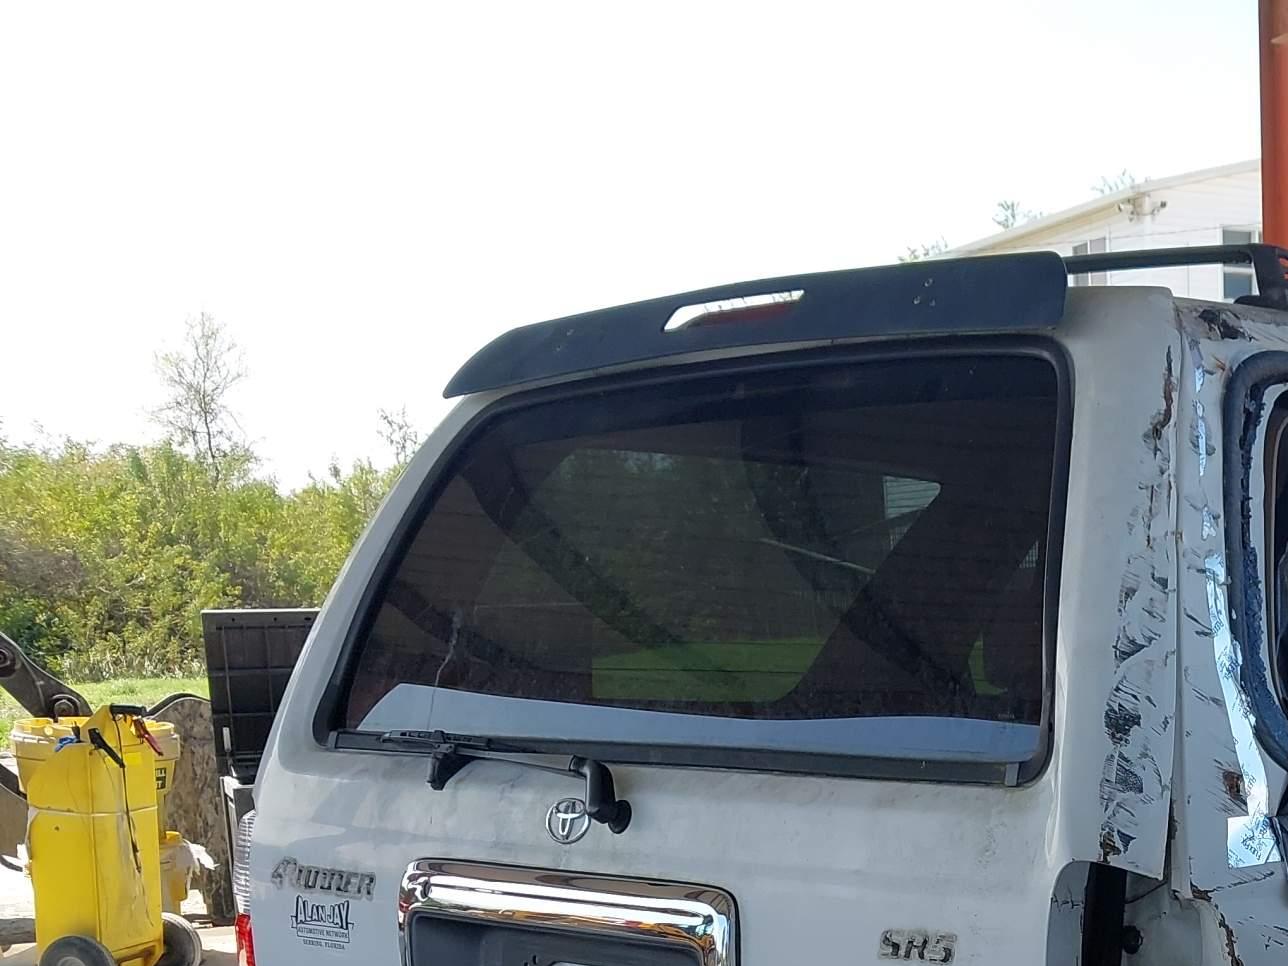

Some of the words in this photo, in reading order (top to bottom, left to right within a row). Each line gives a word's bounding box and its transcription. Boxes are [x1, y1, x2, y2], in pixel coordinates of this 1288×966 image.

[295, 894, 327, 923] ALAN
[326, 900, 350, 931] JAY
[879, 930, 957, 965] SR5
